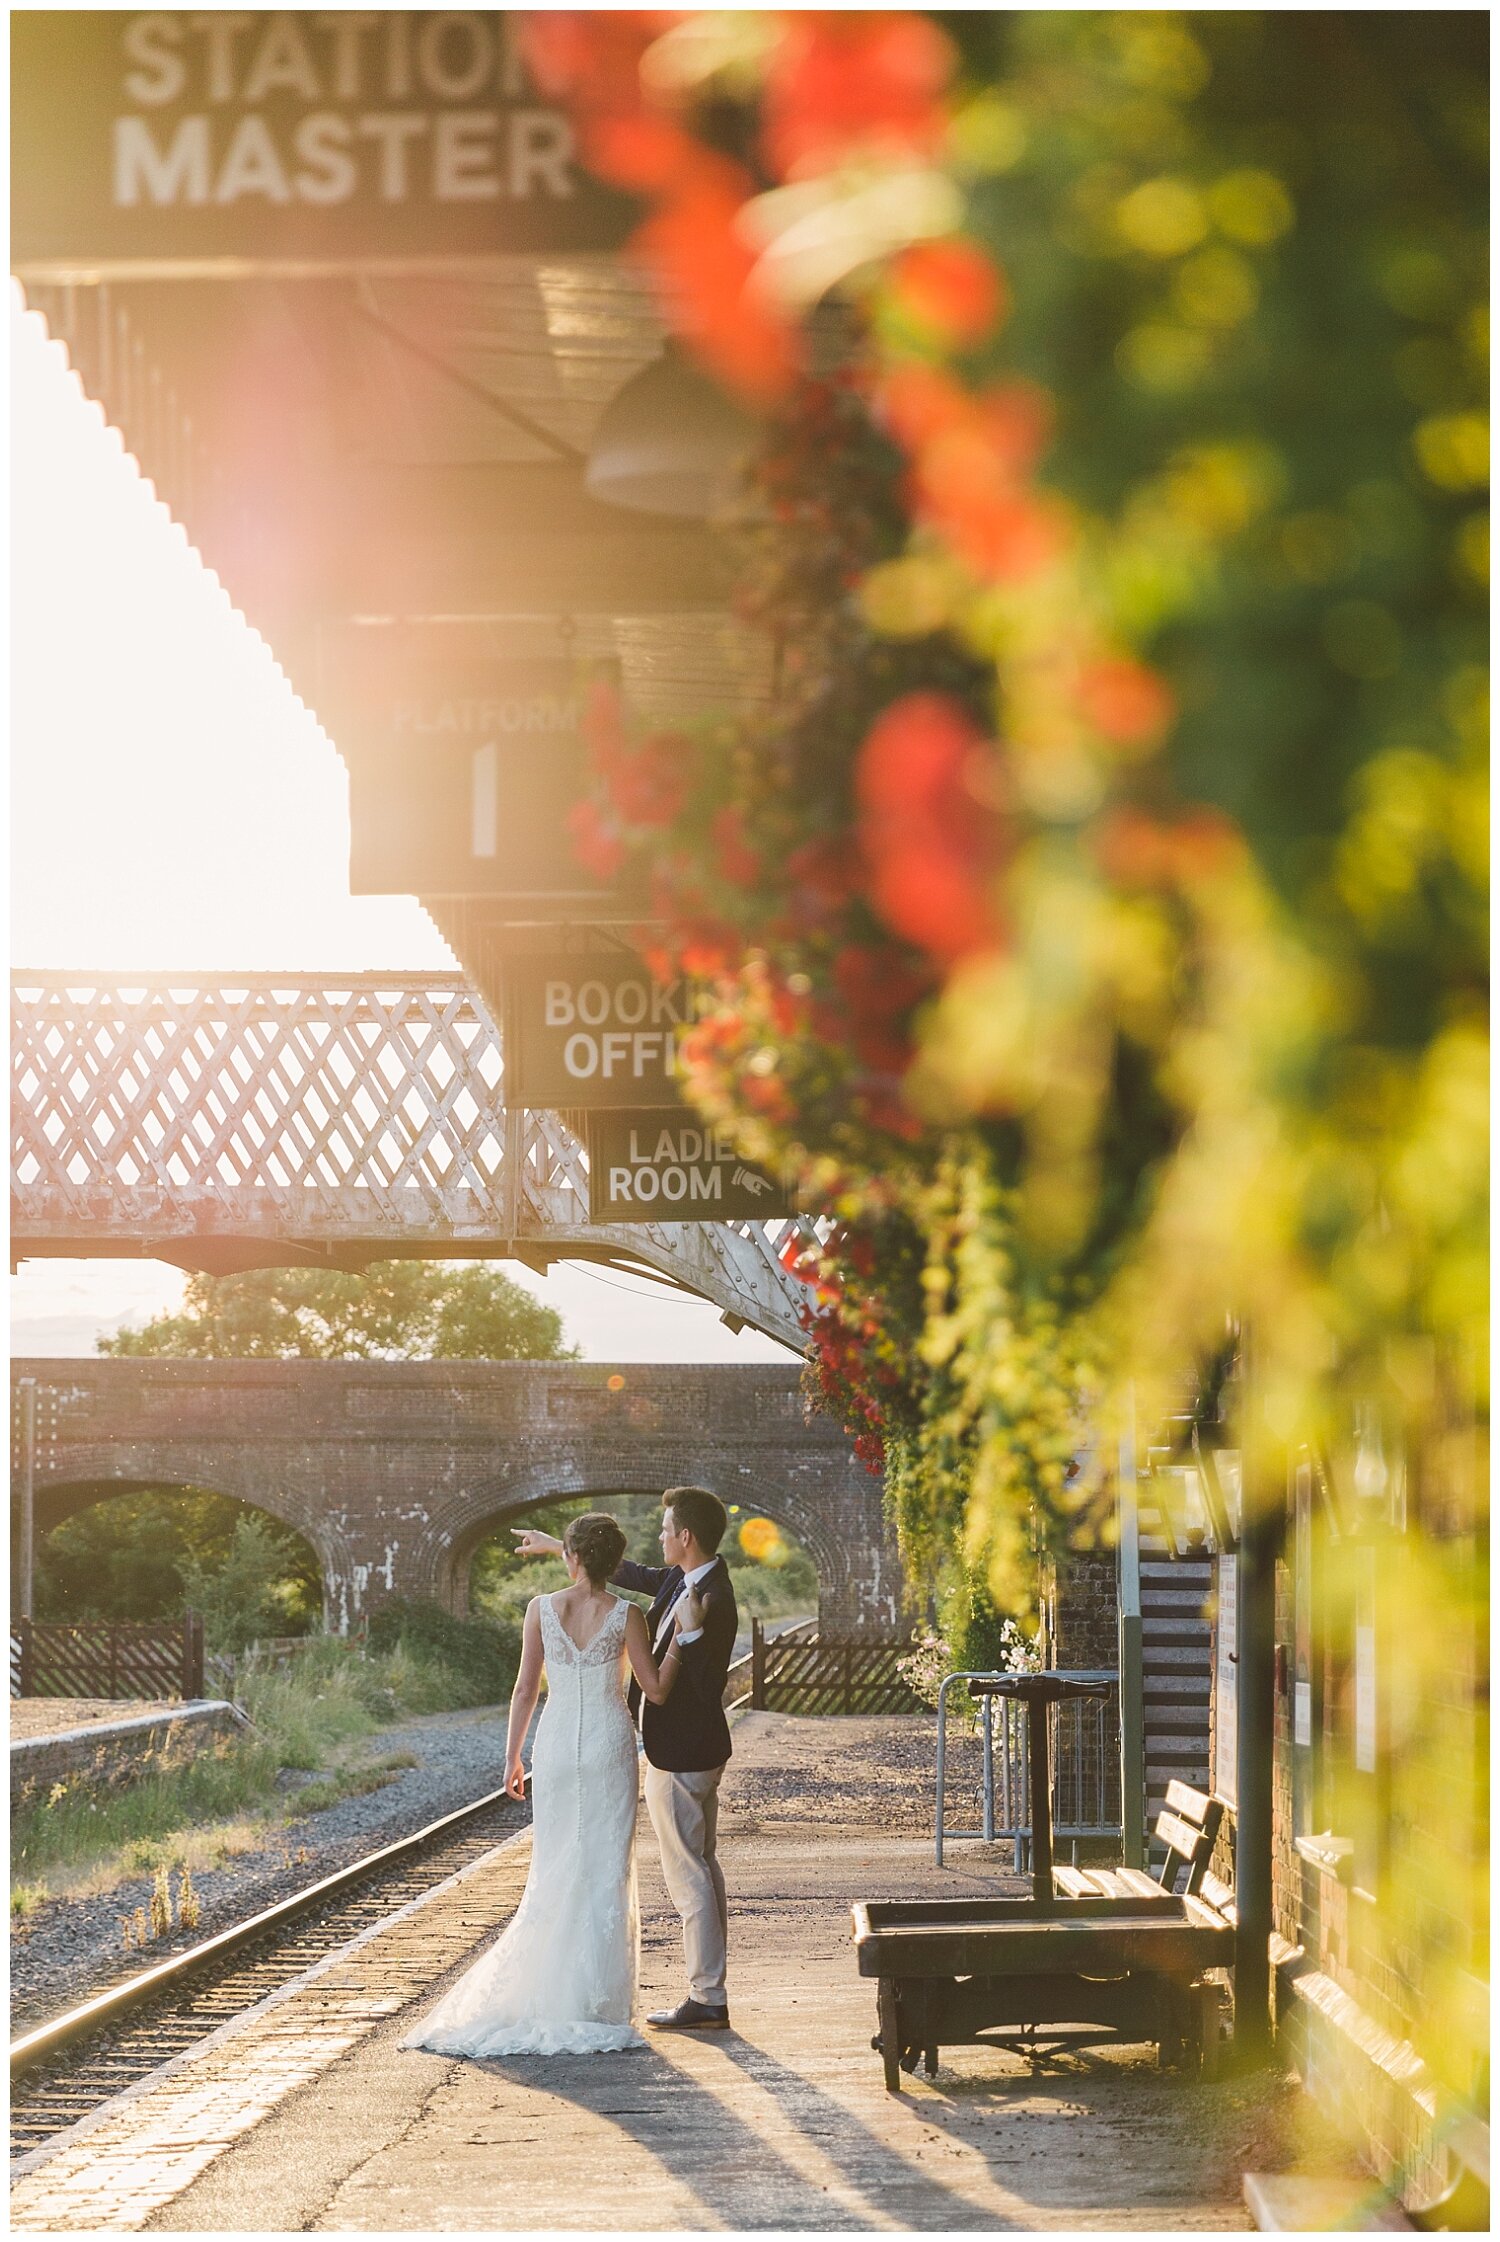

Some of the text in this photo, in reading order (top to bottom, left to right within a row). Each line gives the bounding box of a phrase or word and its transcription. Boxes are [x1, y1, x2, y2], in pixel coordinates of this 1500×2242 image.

[113, 108, 577, 206] MASTER
[394, 698, 577, 734] PLATFORM
[471, 741, 497, 859] 1
[545, 980, 698, 1026] BOOKI
[564, 1032, 686, 1078] OFFI
[609, 1165, 722, 1202] ROOM
